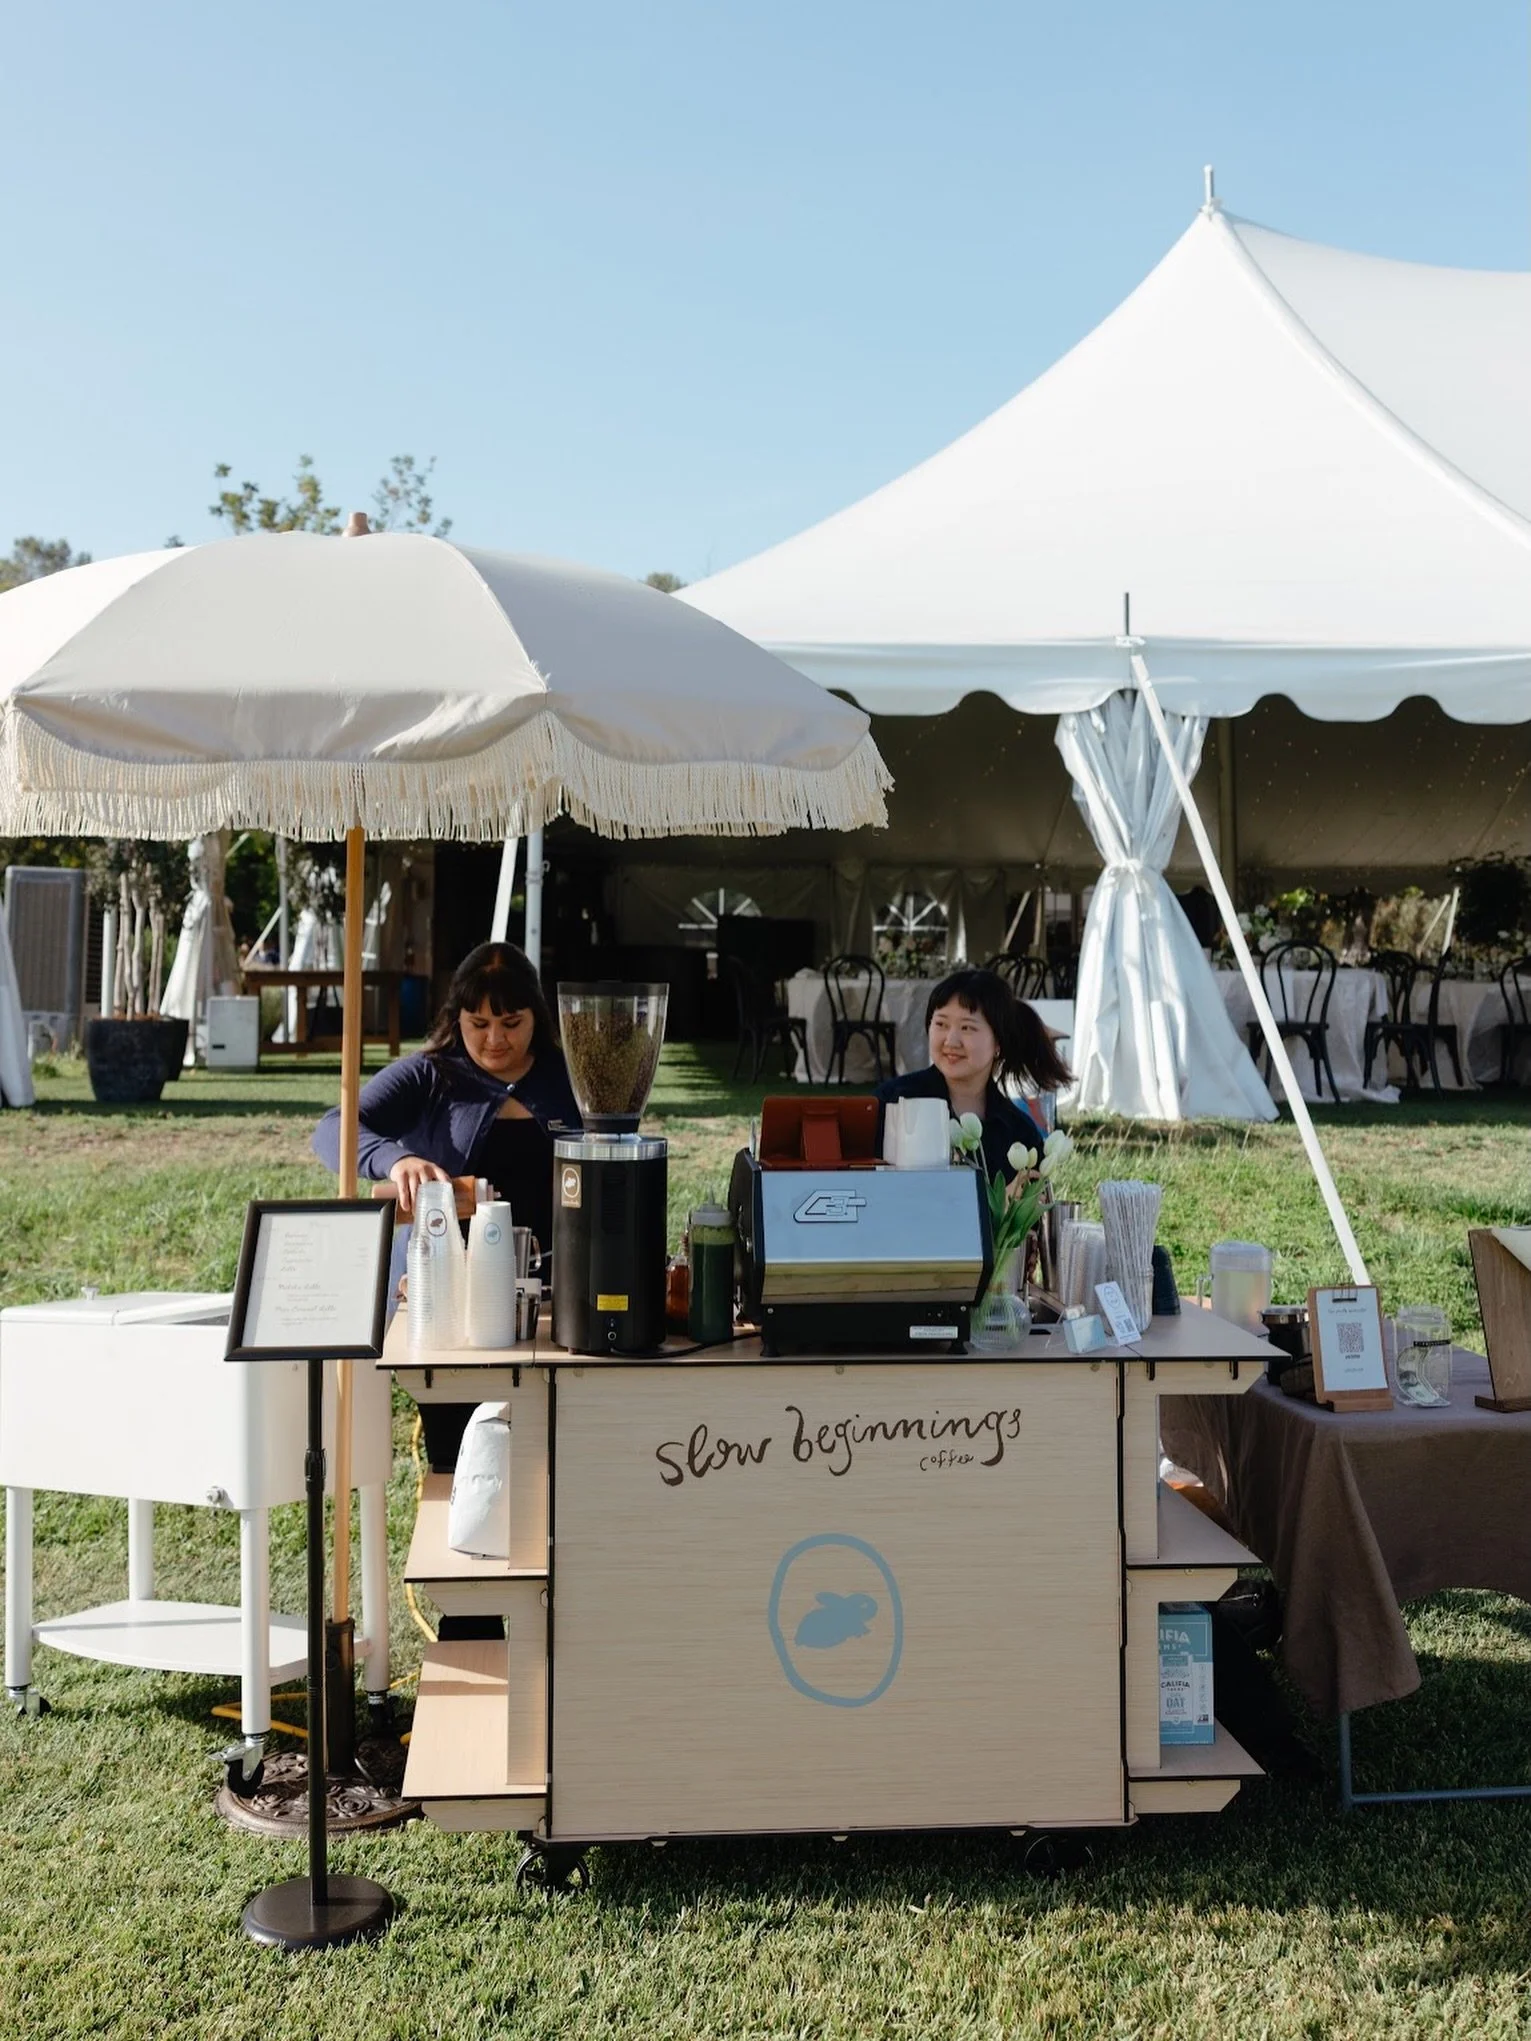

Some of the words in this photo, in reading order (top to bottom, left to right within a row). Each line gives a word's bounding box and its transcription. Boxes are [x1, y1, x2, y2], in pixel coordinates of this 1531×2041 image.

[656, 1424, 771, 1486] slow
[785, 1406, 1021, 1476] beginnings
[920, 1450, 974, 1471] coffee
[1160, 1629, 1191, 1645] IFIA
